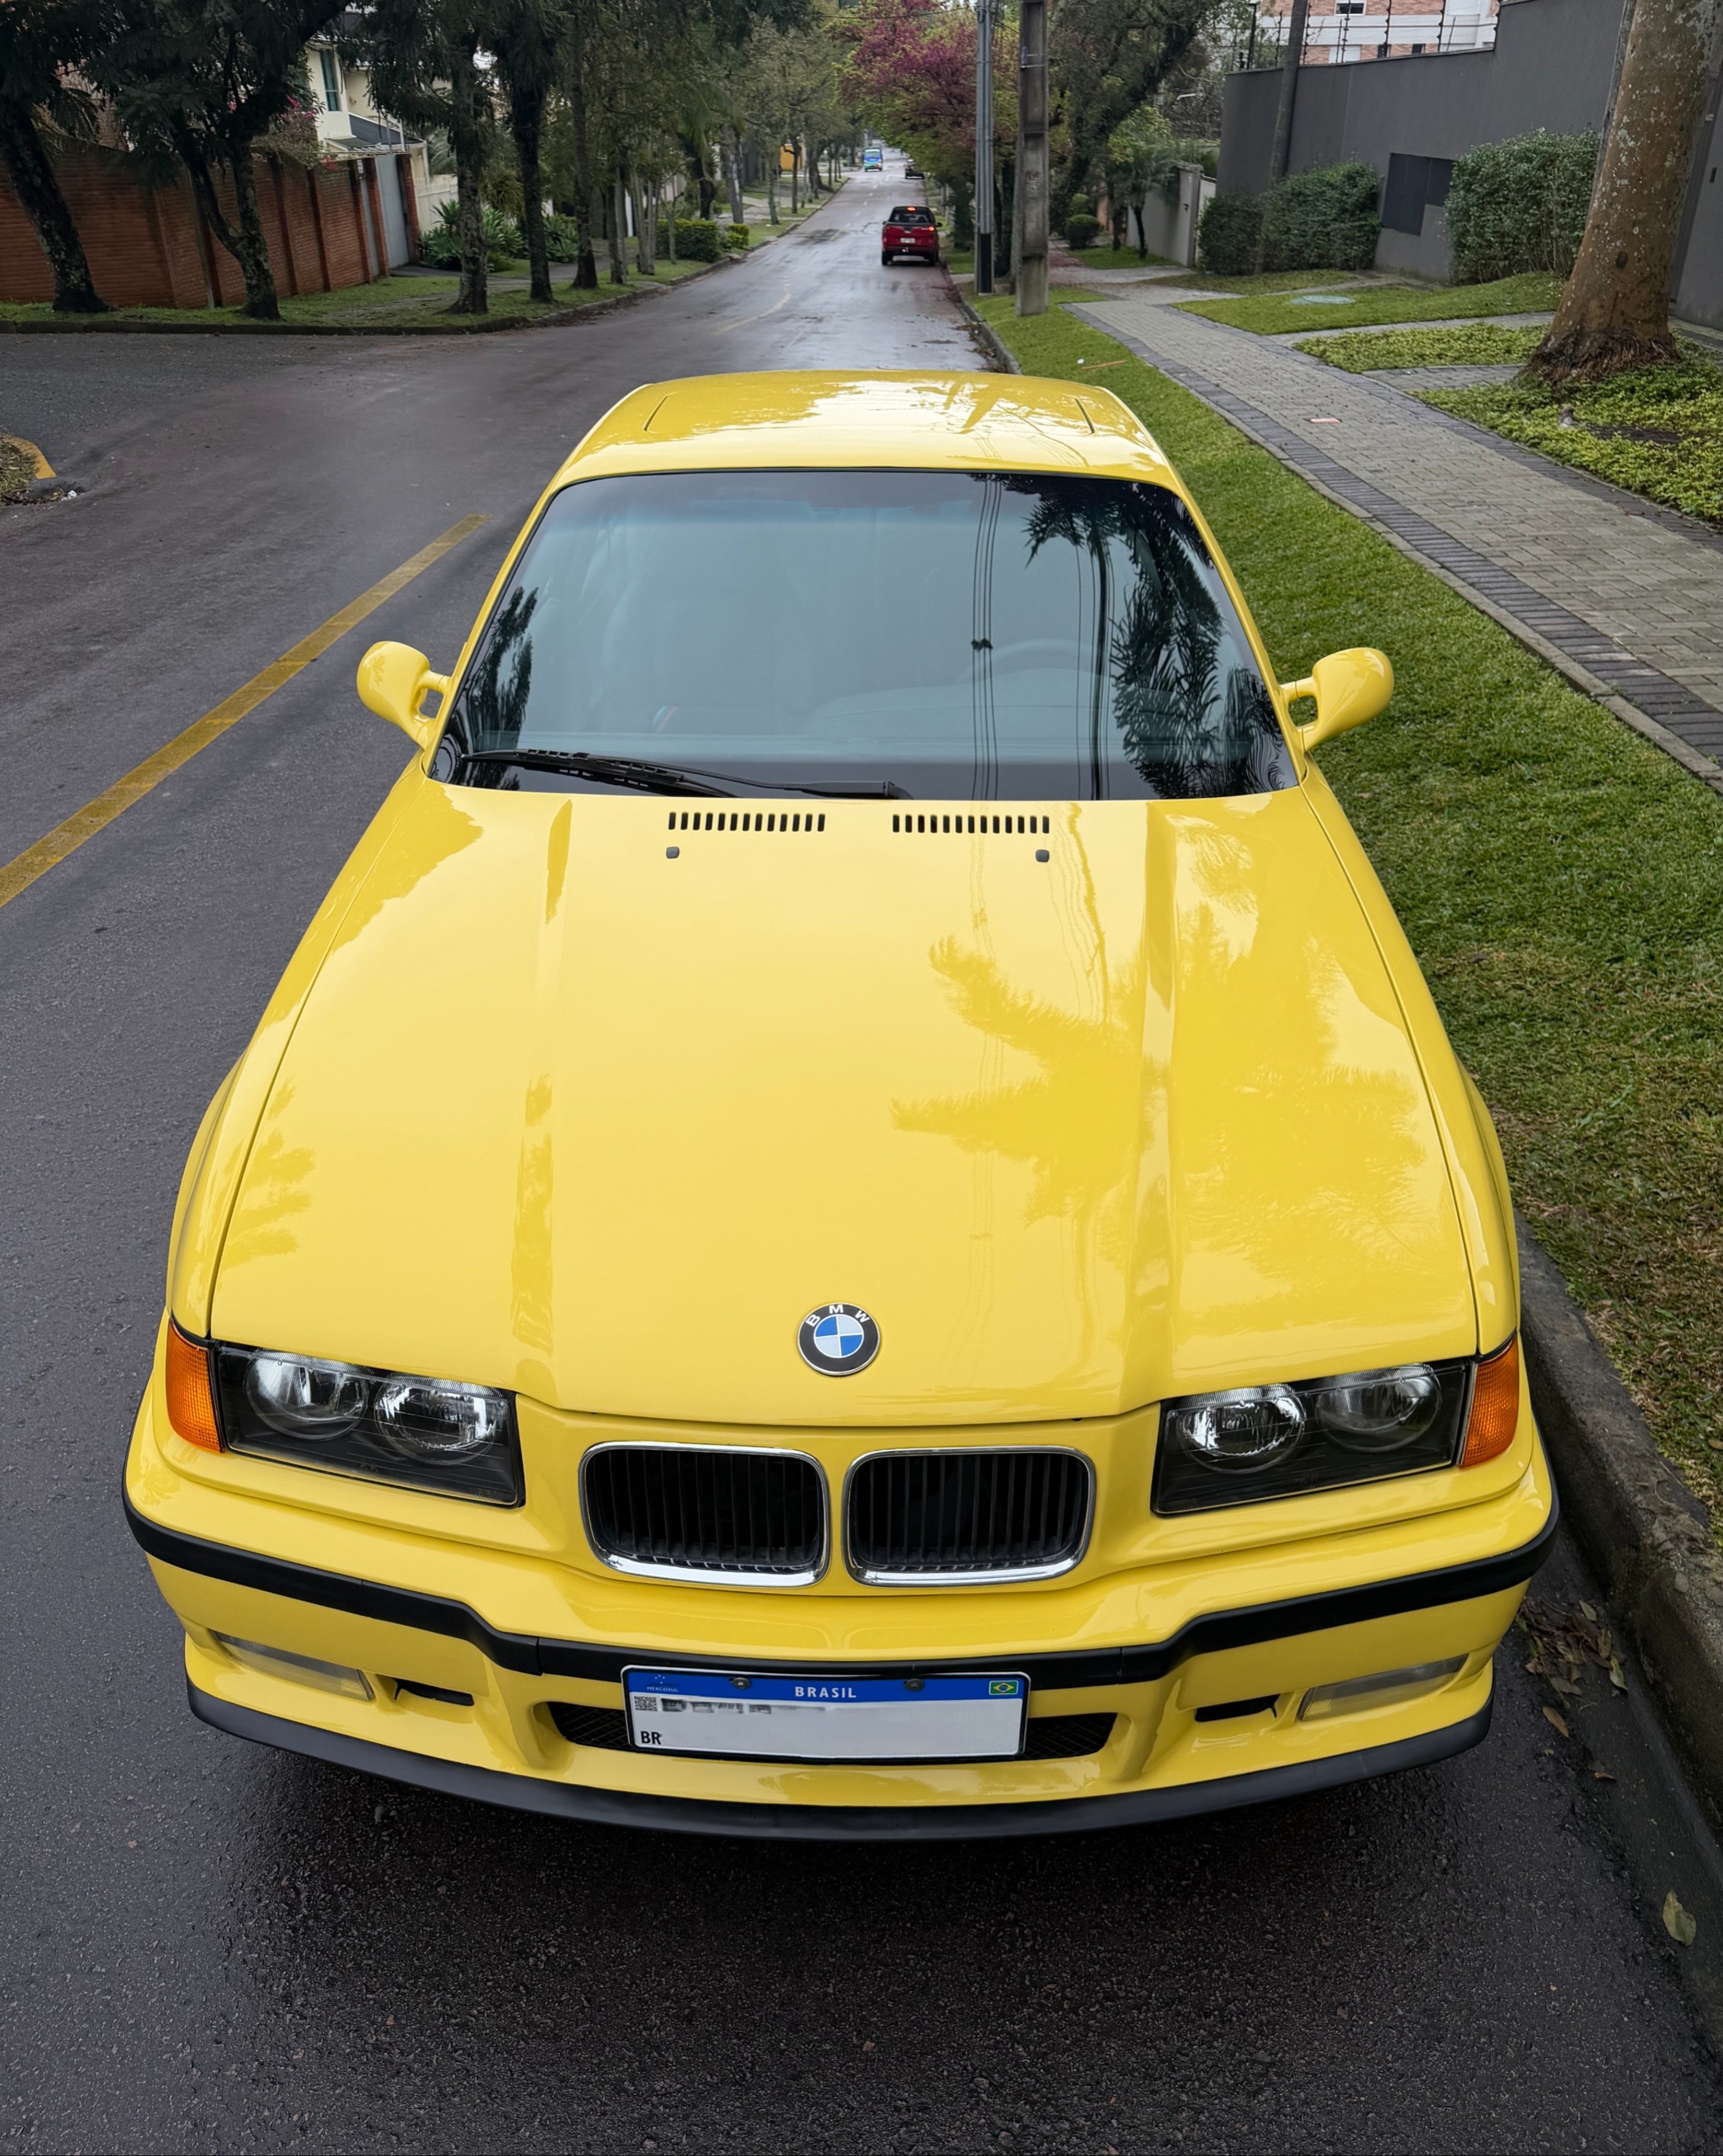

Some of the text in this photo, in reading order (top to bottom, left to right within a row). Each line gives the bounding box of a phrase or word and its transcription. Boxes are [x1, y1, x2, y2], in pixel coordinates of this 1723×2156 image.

[805, 1304, 870, 1327] BMW
[795, 1686, 857, 1698] BRASIL
[640, 1731, 662, 1745] BR
